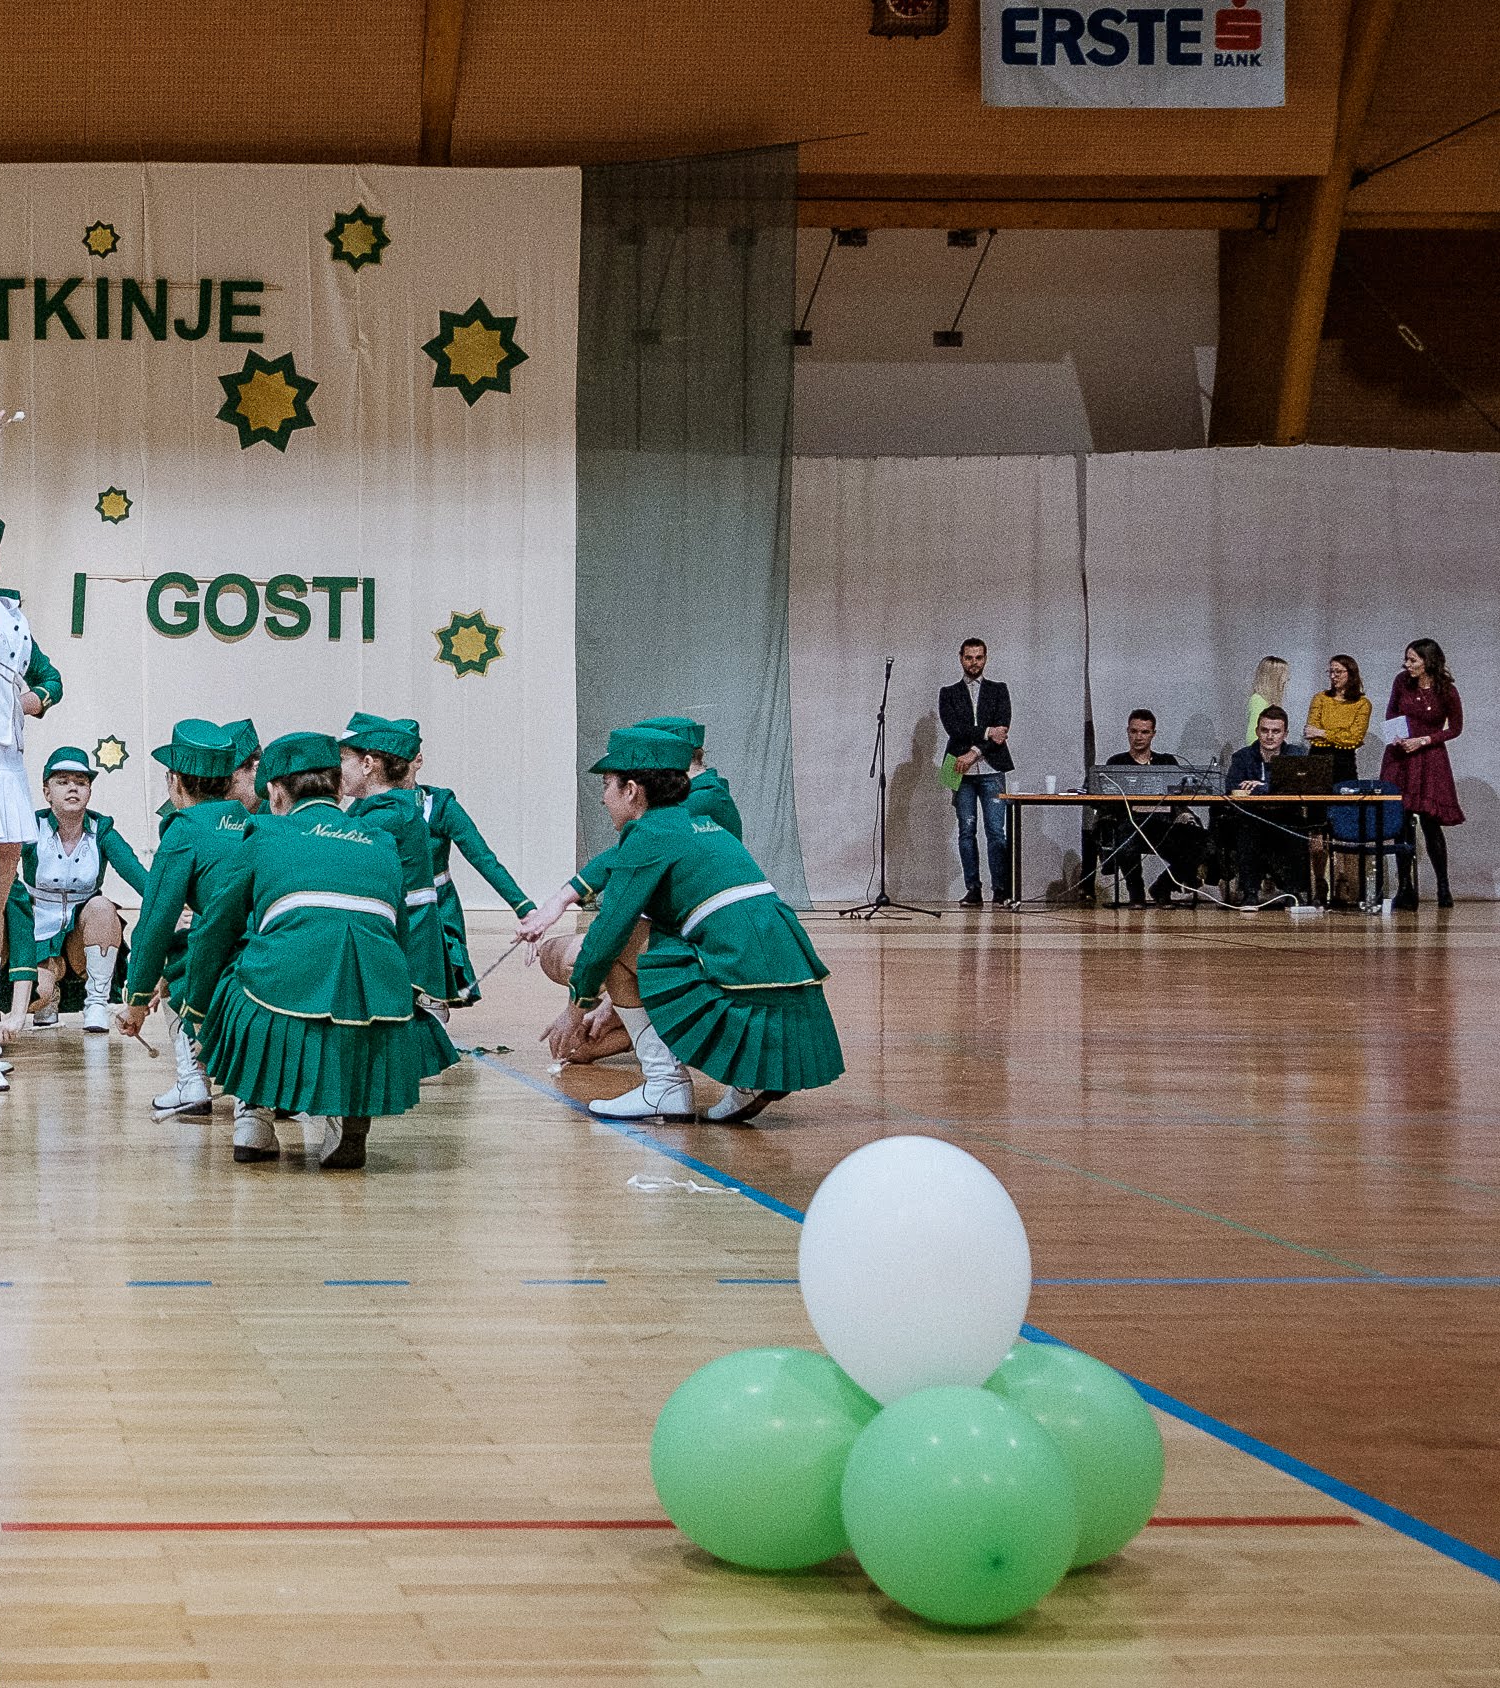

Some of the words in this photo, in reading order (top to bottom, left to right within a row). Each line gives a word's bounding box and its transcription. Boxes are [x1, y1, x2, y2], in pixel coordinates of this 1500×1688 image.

[1001, 7, 1204, 66] ERSTE
[1214, 53, 1263, 67] BANK
[71, 572, 87, 639] I
[146, 572, 376, 643] GOSTI
